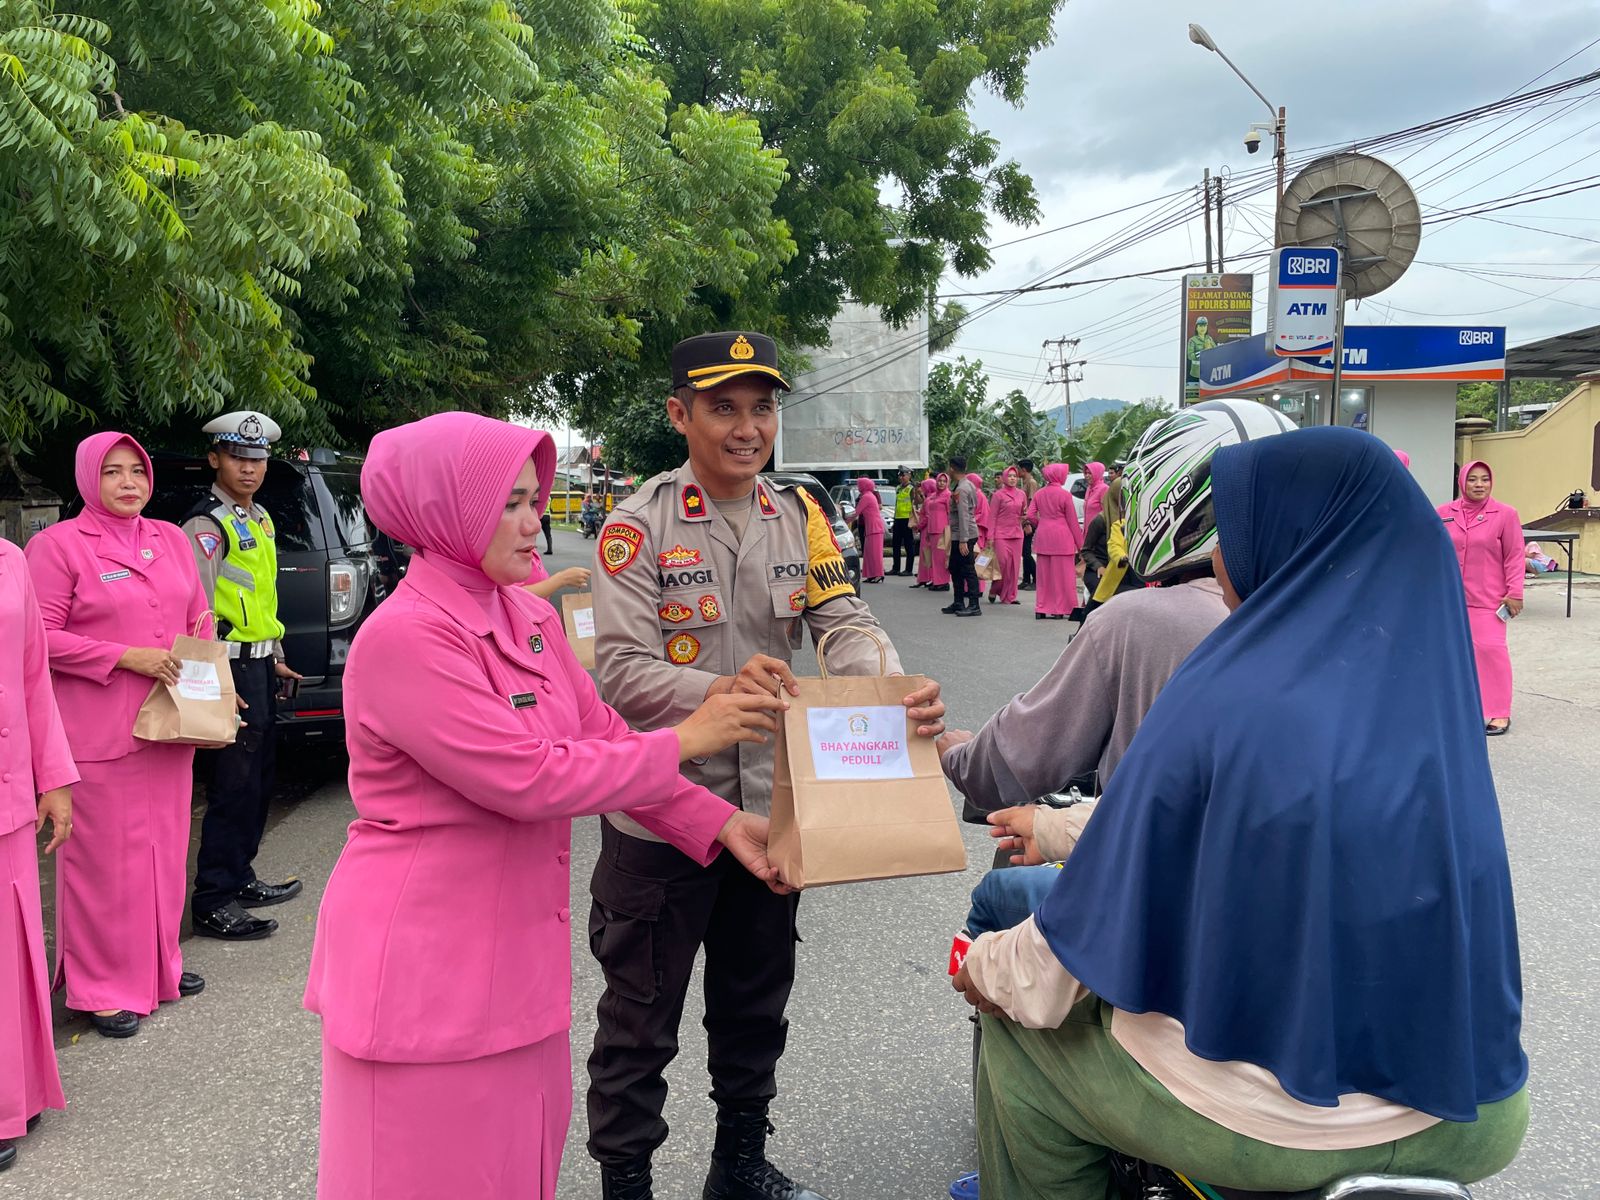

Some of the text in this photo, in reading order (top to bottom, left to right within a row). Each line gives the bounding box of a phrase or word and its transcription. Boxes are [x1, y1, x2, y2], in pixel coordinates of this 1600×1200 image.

[1305, 258, 1330, 274] BRI
[1189, 291, 1221, 299] SELAMAT
[1189, 300, 1198, 309] DI
[1199, 300, 1229, 309] POLRES
[1287, 303, 1327, 316] ATM
[1472, 331, 1493, 344] BRI
[1210, 363, 1231, 382] ATM
[810, 560, 849, 591] WAK
[820, 740, 899, 752] BHAYANGKARI
[841, 755, 881, 765] PEDULI
